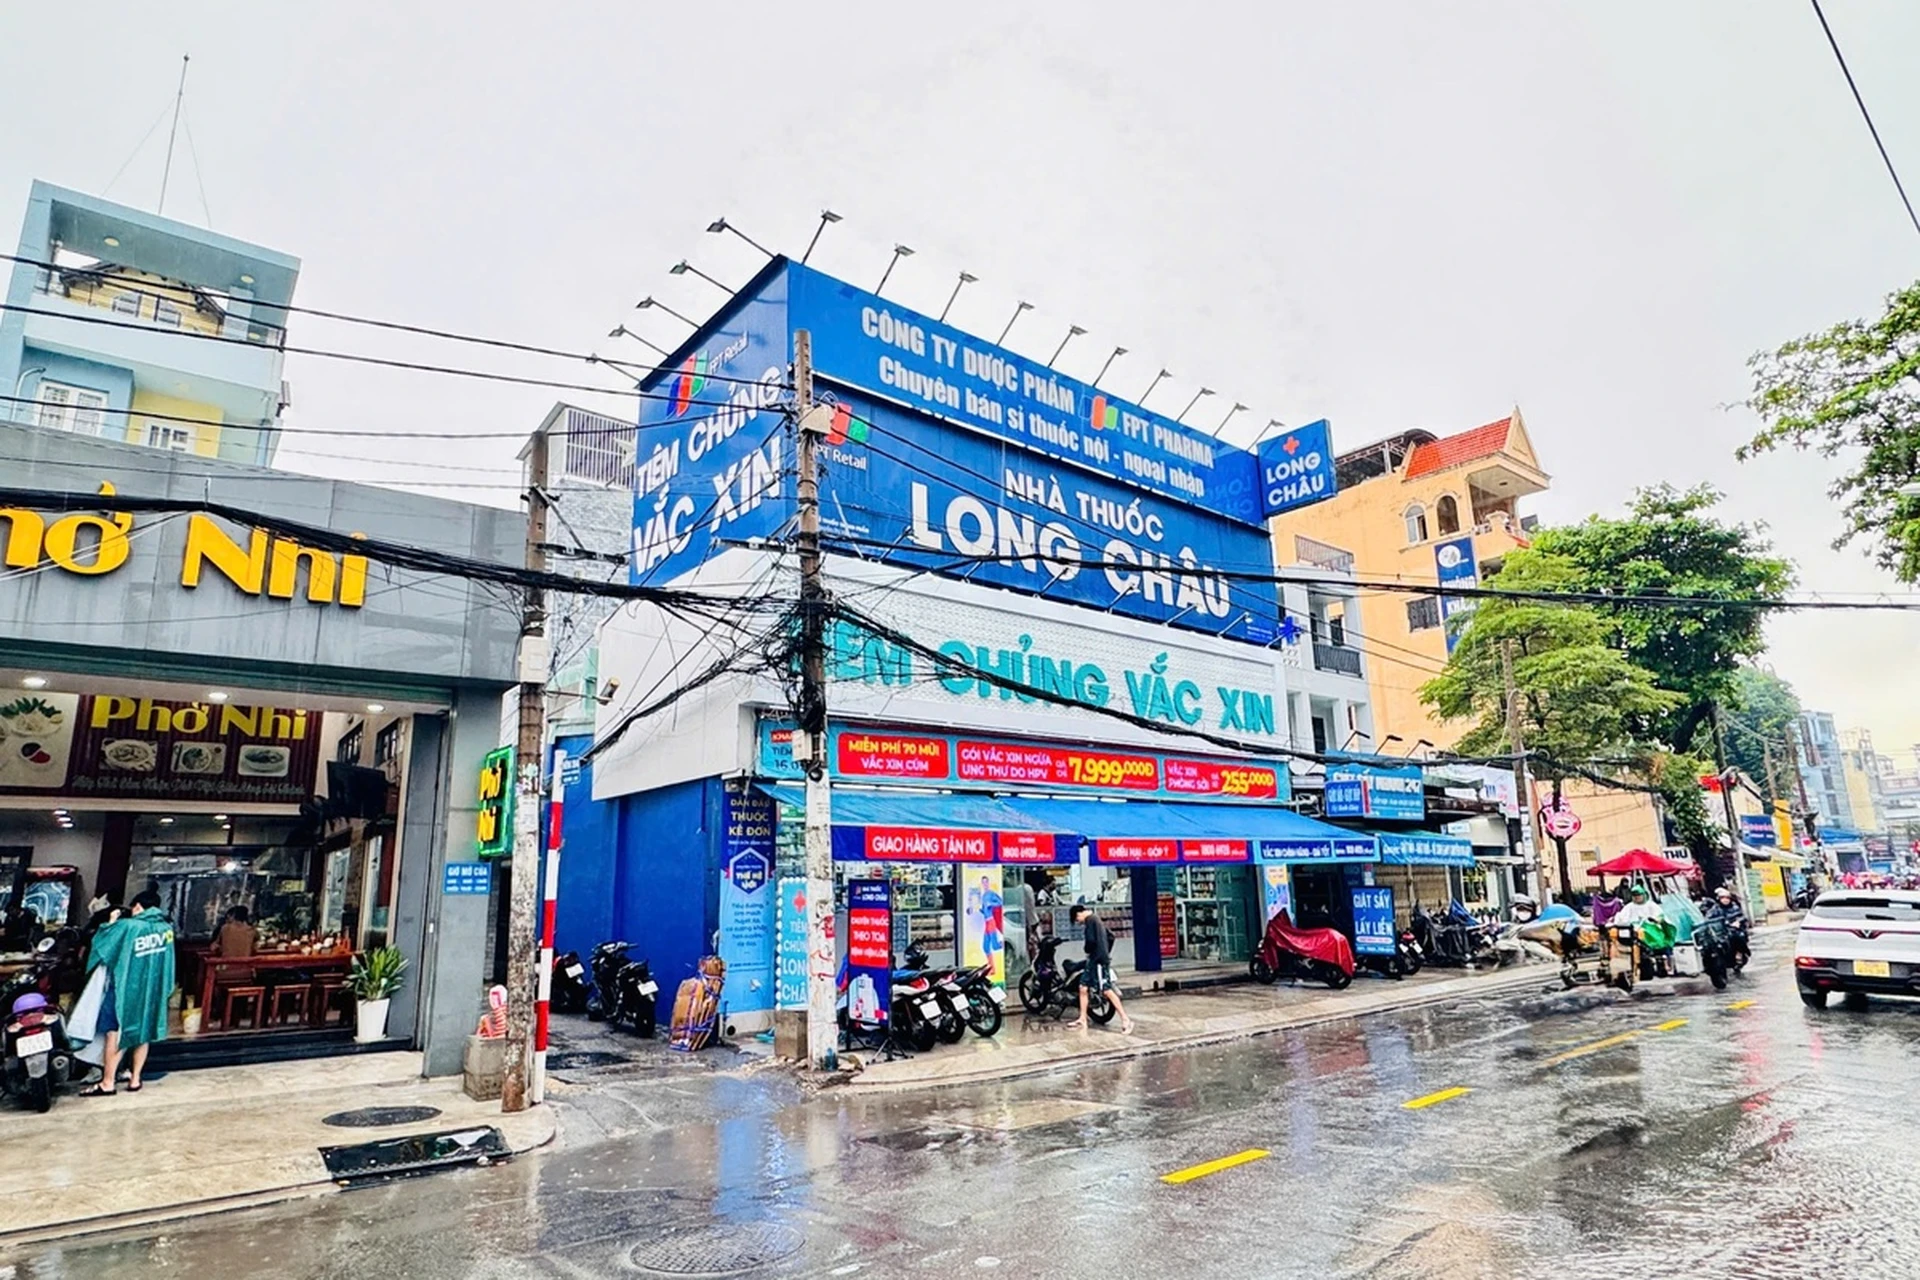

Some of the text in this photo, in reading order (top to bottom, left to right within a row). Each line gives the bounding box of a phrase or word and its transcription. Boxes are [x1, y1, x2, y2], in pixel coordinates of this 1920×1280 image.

[861, 306, 1076, 415] CÔNG TY DƯỢC PHẨM
[637, 366, 781, 499] TIÊM CHỦNG
[879, 355, 960, 409] Chuyên
[966, 393, 1003, 425] bán
[1029, 412, 1079, 452] thuốc
[1084, 435, 1110, 464] nội
[1123, 451, 1166, 485] ngoại
[833, 449, 867, 470] Retail
[1122, 412, 1214, 469] FPT PHARMA
[1266, 451, 1322, 485] LONG
[634, 435, 781, 575] VẮC XIN
[1005, 468, 1164, 542] NHÀ THUỐC
[1268, 473, 1325, 507] CHÂU
[911, 481, 1230, 619] LONG CHÂU
[934, 633, 1111, 708] CHỦNG
[1125, 652, 1203, 725] VẮC
[1217, 686, 1276, 735] XIN
[91, 694, 307, 740] Phở Nhi
[848, 736, 879, 753] MIỄN
[881, 740, 901, 755] PHÍ
[902, 743, 917, 755] 70
[861, 754, 884, 769] VẮC
[886, 758, 903, 770] XIN
[961, 746, 981, 760] GÓI
[982, 746, 1004, 761] VẮC
[1006, 752, 1023, 764] XIN
[1010, 766, 1026, 778] DO
[1027, 768, 1048, 779] HPV
[872, 833, 985, 859] GIAO HÀNG TẬN NƠI
[134, 932, 168, 951] BIDV
